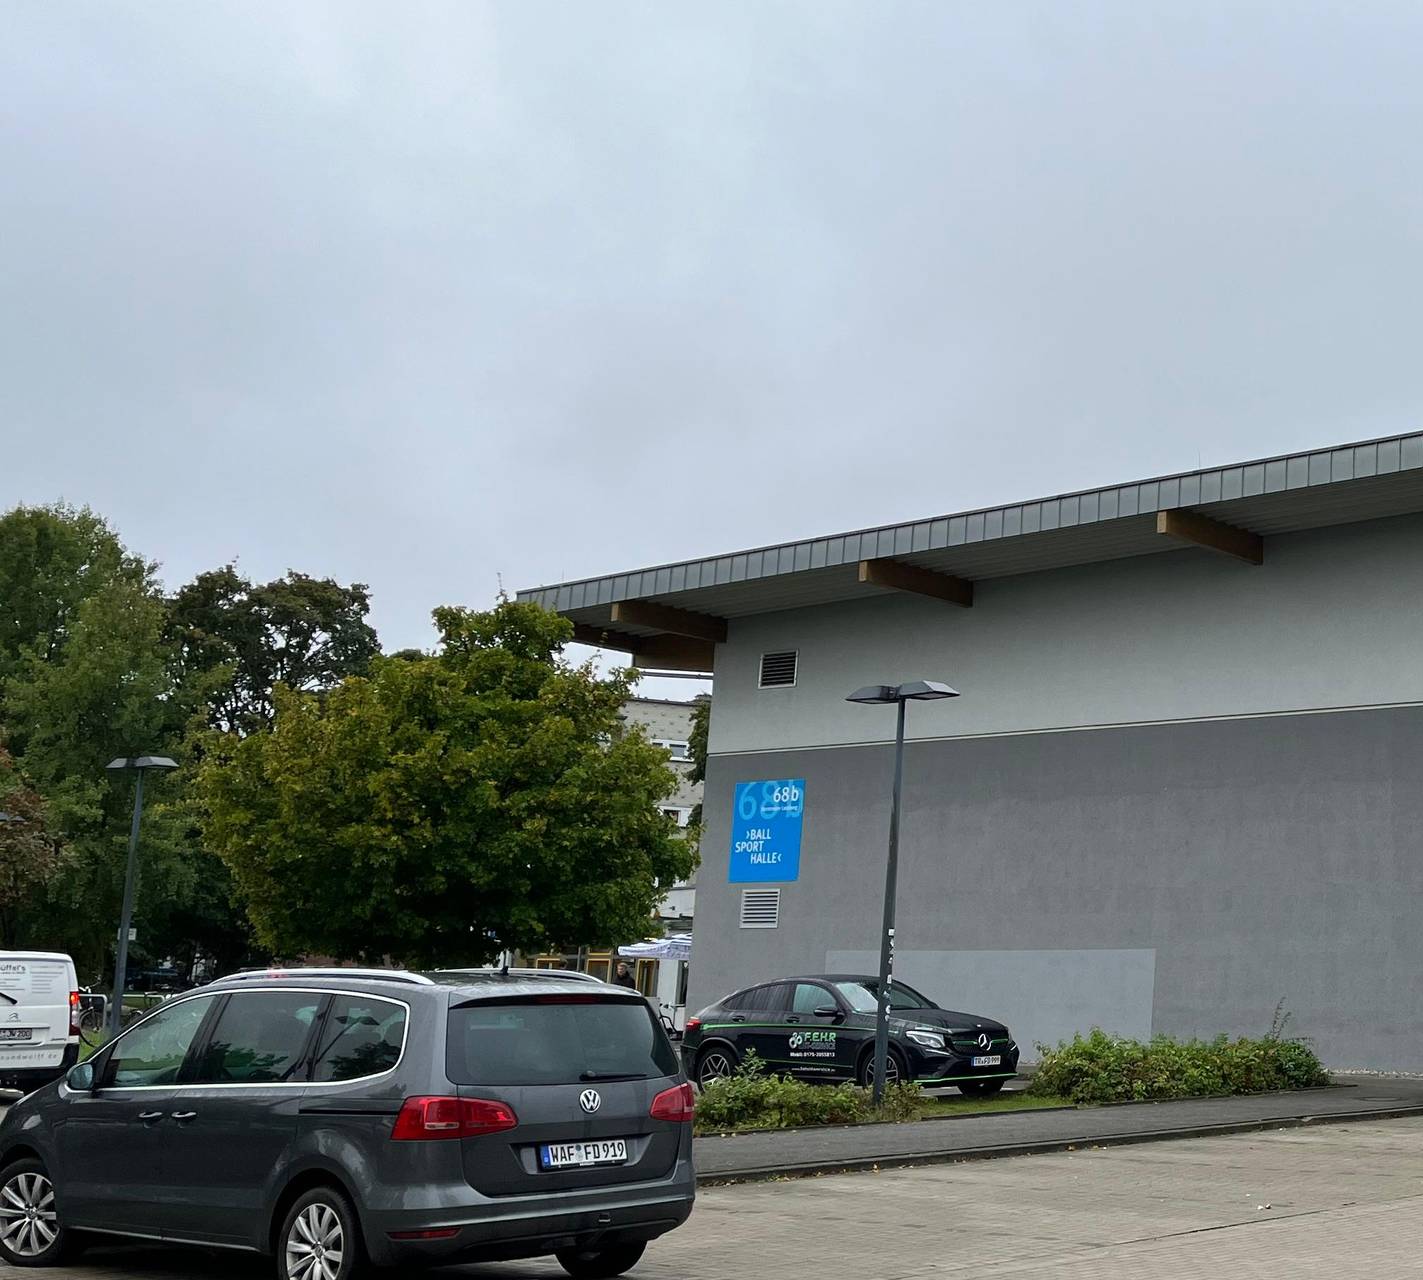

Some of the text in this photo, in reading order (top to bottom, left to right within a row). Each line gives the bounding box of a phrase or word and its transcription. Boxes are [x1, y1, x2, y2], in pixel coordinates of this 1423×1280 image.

[735, 840, 764, 853] SPORT
[550, 1142, 625, 1163] WAF FD 919
